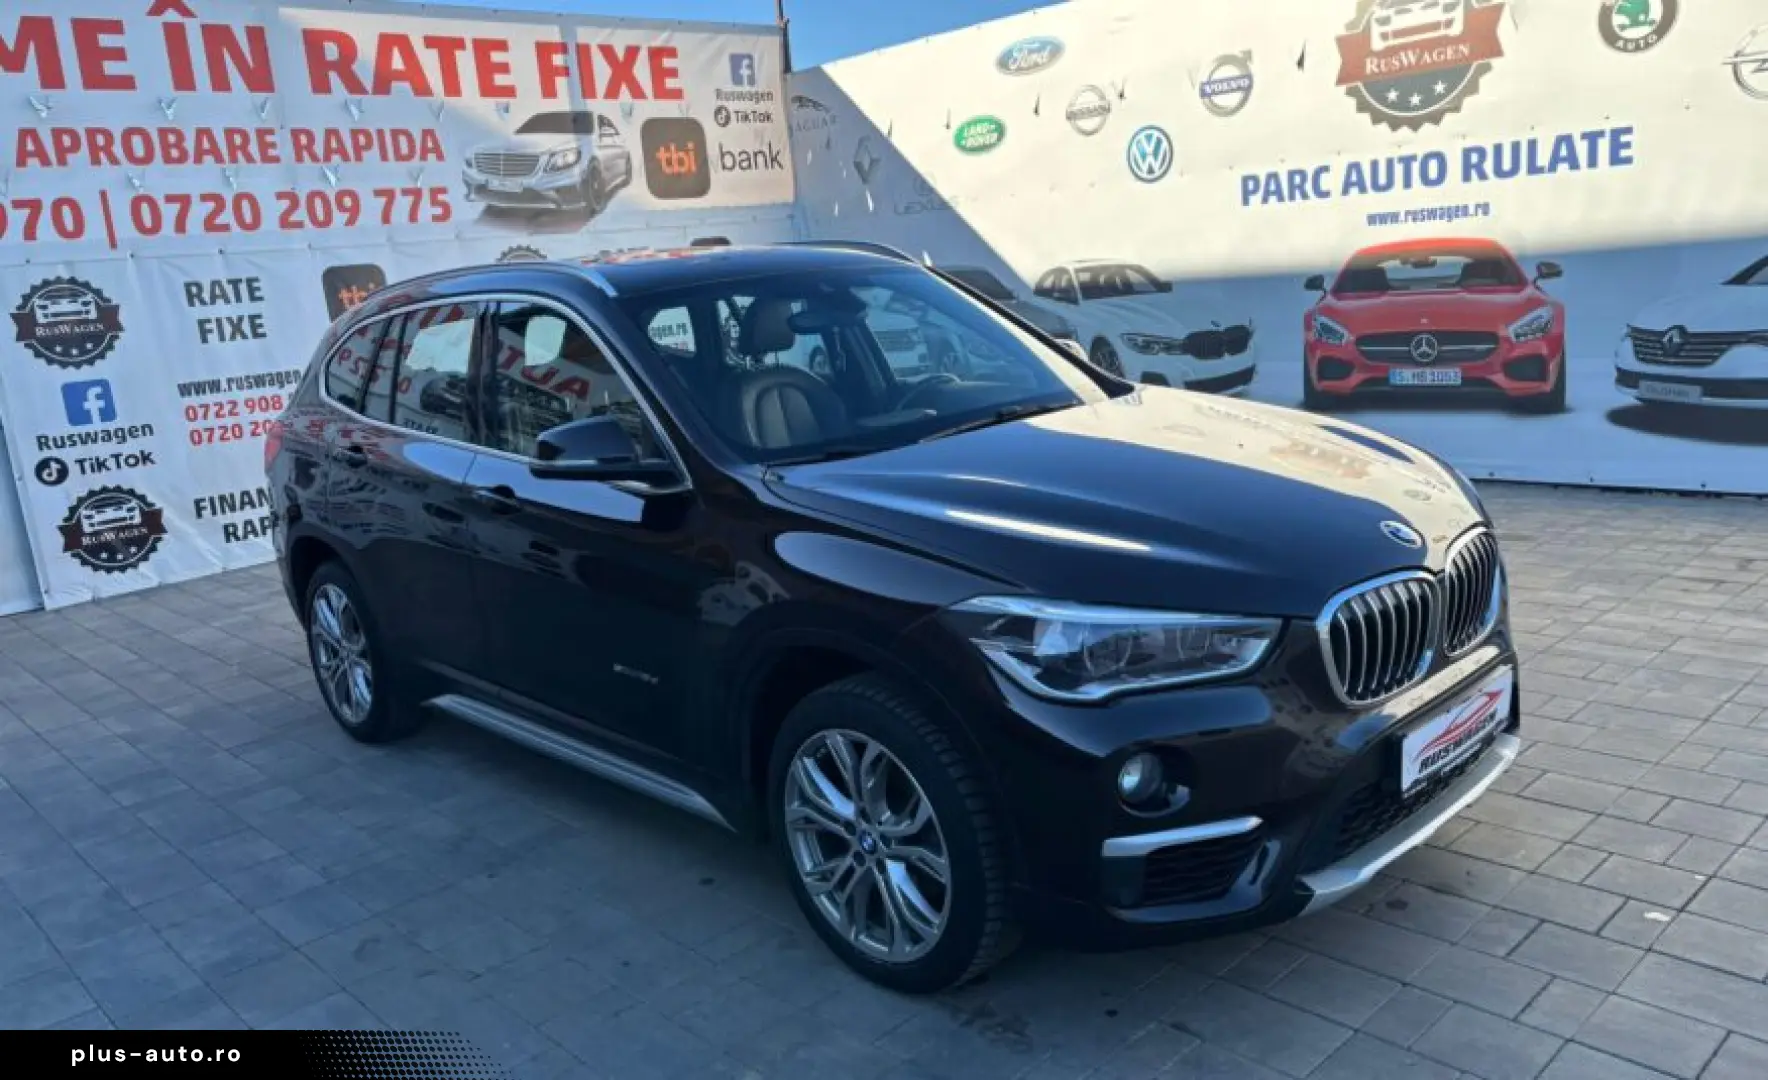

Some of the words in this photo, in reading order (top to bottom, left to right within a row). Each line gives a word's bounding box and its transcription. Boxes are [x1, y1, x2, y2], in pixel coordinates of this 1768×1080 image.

[147, 0, 276, 93] ÎN
[302, 28, 517, 99] RATE
[535, 41, 685, 101] FIXE
[715, 88, 774, 105] Ruswagen
[733, 110, 774, 124] TikTok
[795, 114, 837, 132] AGUAR
[15, 127, 281, 168] APROBARE
[290, 128, 446, 163] RAPIDA
[655, 142, 697, 175] tbi
[718, 140, 784, 171] bank
[1241, 165, 1331, 207] PARC
[1341, 150, 1448, 196] AUTO
[1461, 126, 1634, 183] RULATE
[0, 196, 86, 241] 70
[130, 192, 262, 236] 0720
[274, 189, 361, 230] 209
[373, 187, 452, 223] 775
[1366, 202, 1490, 226] www.ruswagen.ro
[183, 276, 265, 308] RATE
[197, 313, 267, 344] FIXE
[184, 400, 240, 423] 0722
[244, 394, 284, 414] 908
[36, 424, 154, 451] Ruswagen
[189, 423, 244, 447] 0720
[75, 450, 156, 476] TikTok
